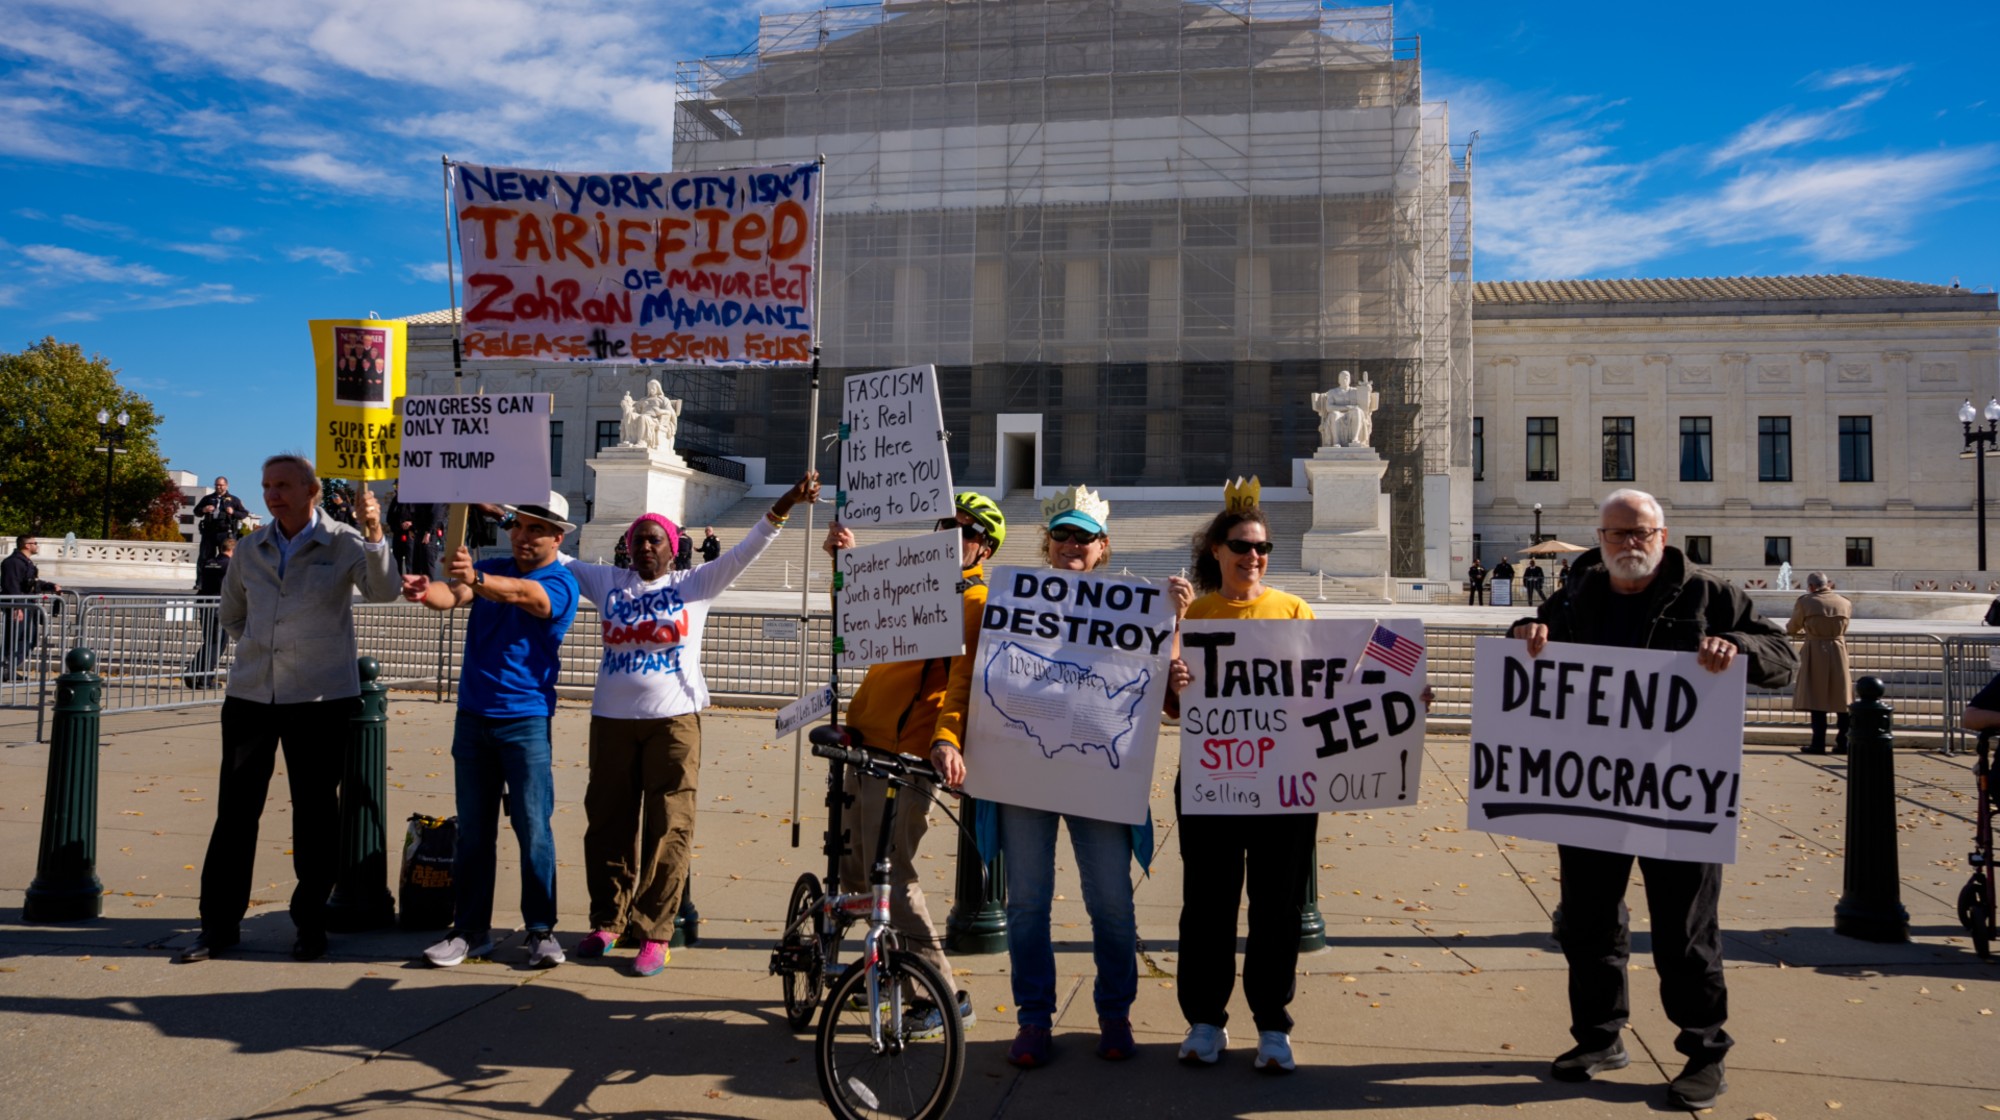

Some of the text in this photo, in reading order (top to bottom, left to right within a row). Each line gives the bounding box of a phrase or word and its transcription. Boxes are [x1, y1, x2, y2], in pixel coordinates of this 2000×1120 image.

[459, 166, 549, 201] NEW
[555, 174, 663, 214] YORK
[672, 176, 735, 210] CITY
[624, 268, 662, 290] OF
[639, 288, 809, 330] MAMDANI
[587, 328, 629, 359] the
[848, 371, 923, 404] FASCISM
[405, 395, 534, 415] CONGRESS CAN
[848, 400, 912, 433] It's Real
[329, 421, 396, 439] SUPREME
[405, 417, 489, 436] ONLY TAX!
[334, 437, 387, 454] RUBBER
[338, 453, 400, 469] STAMPS
[404, 451, 495, 469] NOT TRUMP
[847, 436, 912, 463] It's Here
[847, 458, 940, 491] What are YOU
[844, 488, 940, 522] Going to Do?
[1045, 497, 1071, 516] NO
[1231, 495, 1254, 509] NO
[844, 544, 955, 583] Speaker Johnson is
[845, 572, 939, 606] Such a Hypocrite
[1013, 573, 1160, 615] DO NOT
[843, 603, 948, 633] Even Jesus Wants
[982, 604, 1171, 655] DESTROY
[842, 635, 919, 663] to Slap Him
[1009, 655, 1030, 676] We
[1502, 656, 1698, 733] DEFEND
[1185, 707, 1287, 735] SCOTUS
[1303, 691, 1416, 759] IED
[1200, 737, 1275, 770] STOP
[1193, 782, 1260, 808] Selling
[1278, 772, 1317, 808] US
[1474, 742, 1740, 818] DEMOCRACY!
